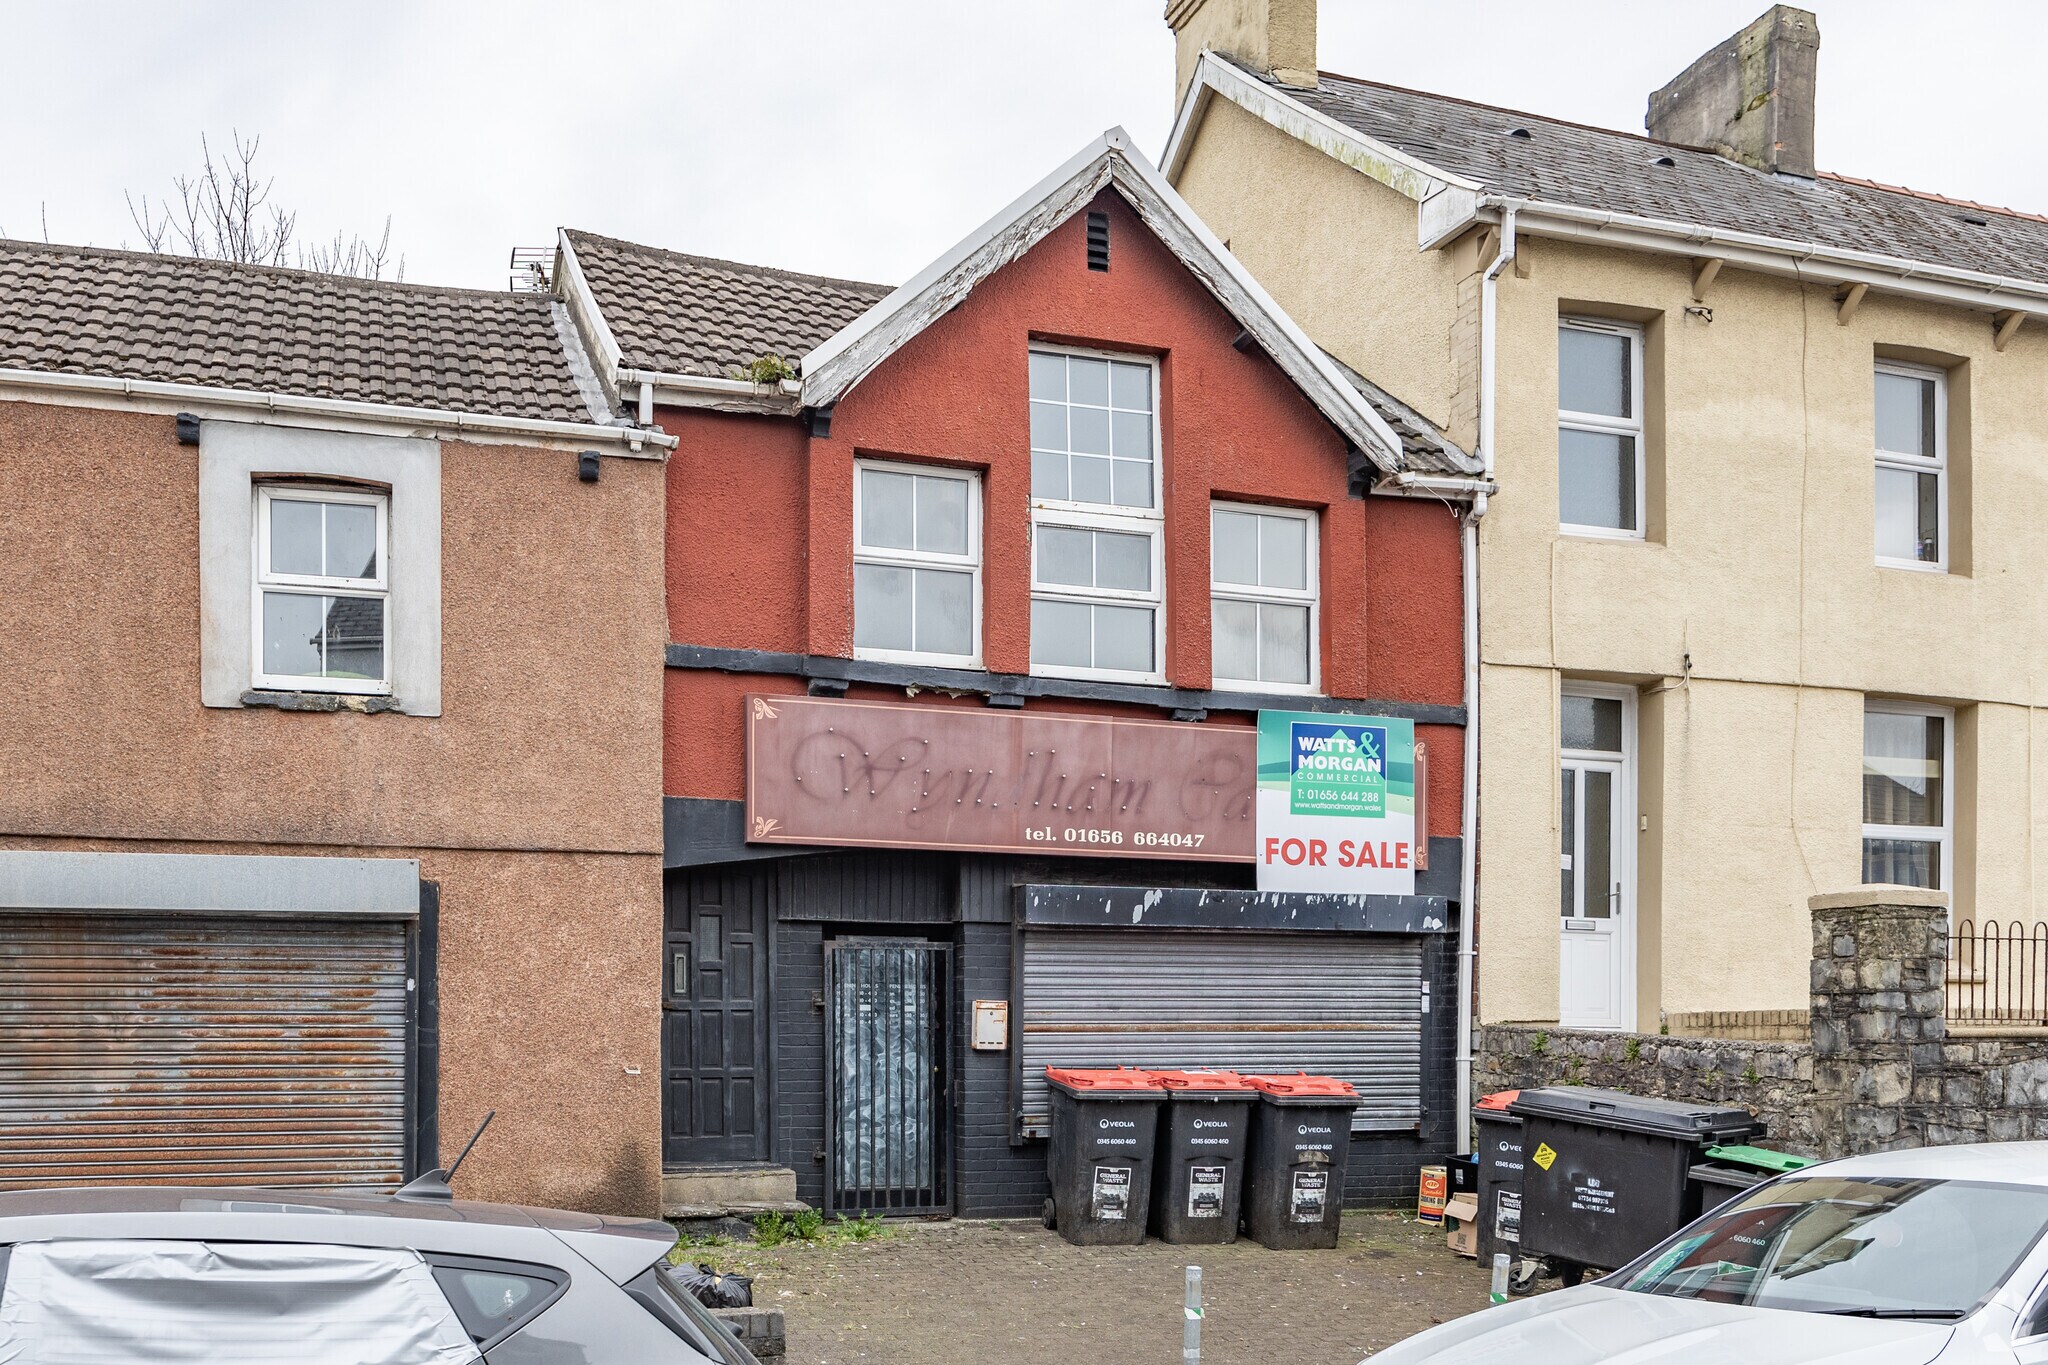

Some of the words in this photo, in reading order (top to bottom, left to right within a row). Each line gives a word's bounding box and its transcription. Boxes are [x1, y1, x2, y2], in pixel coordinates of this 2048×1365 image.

[1298, 737, 1356, 753] WATTS
[1357, 732, 1380, 759] &
[1298, 755, 1381, 772] MORGAN
[1297, 772, 1378, 783] COMMERCIAL
[1297, 789, 1304, 799] T:
[1307, 789, 1338, 800] 01656
[1341, 791, 1359, 801] 644
[1361, 792, 1379, 802] 288
[1295, 802, 1381, 811] www.wattsandmorgan.wales
[1025, 827, 1056, 841] tel.
[1064, 828, 1123, 844] 01656
[1133, 832, 1205, 847] 664047
[1265, 837, 1328, 866] FOR
[1338, 840, 1409, 869] SALE
[1495, 1160, 1509, 1168] 0345
[1733, 1234, 1751, 1243] 6060
[1752, 1238, 1766, 1246] 460
